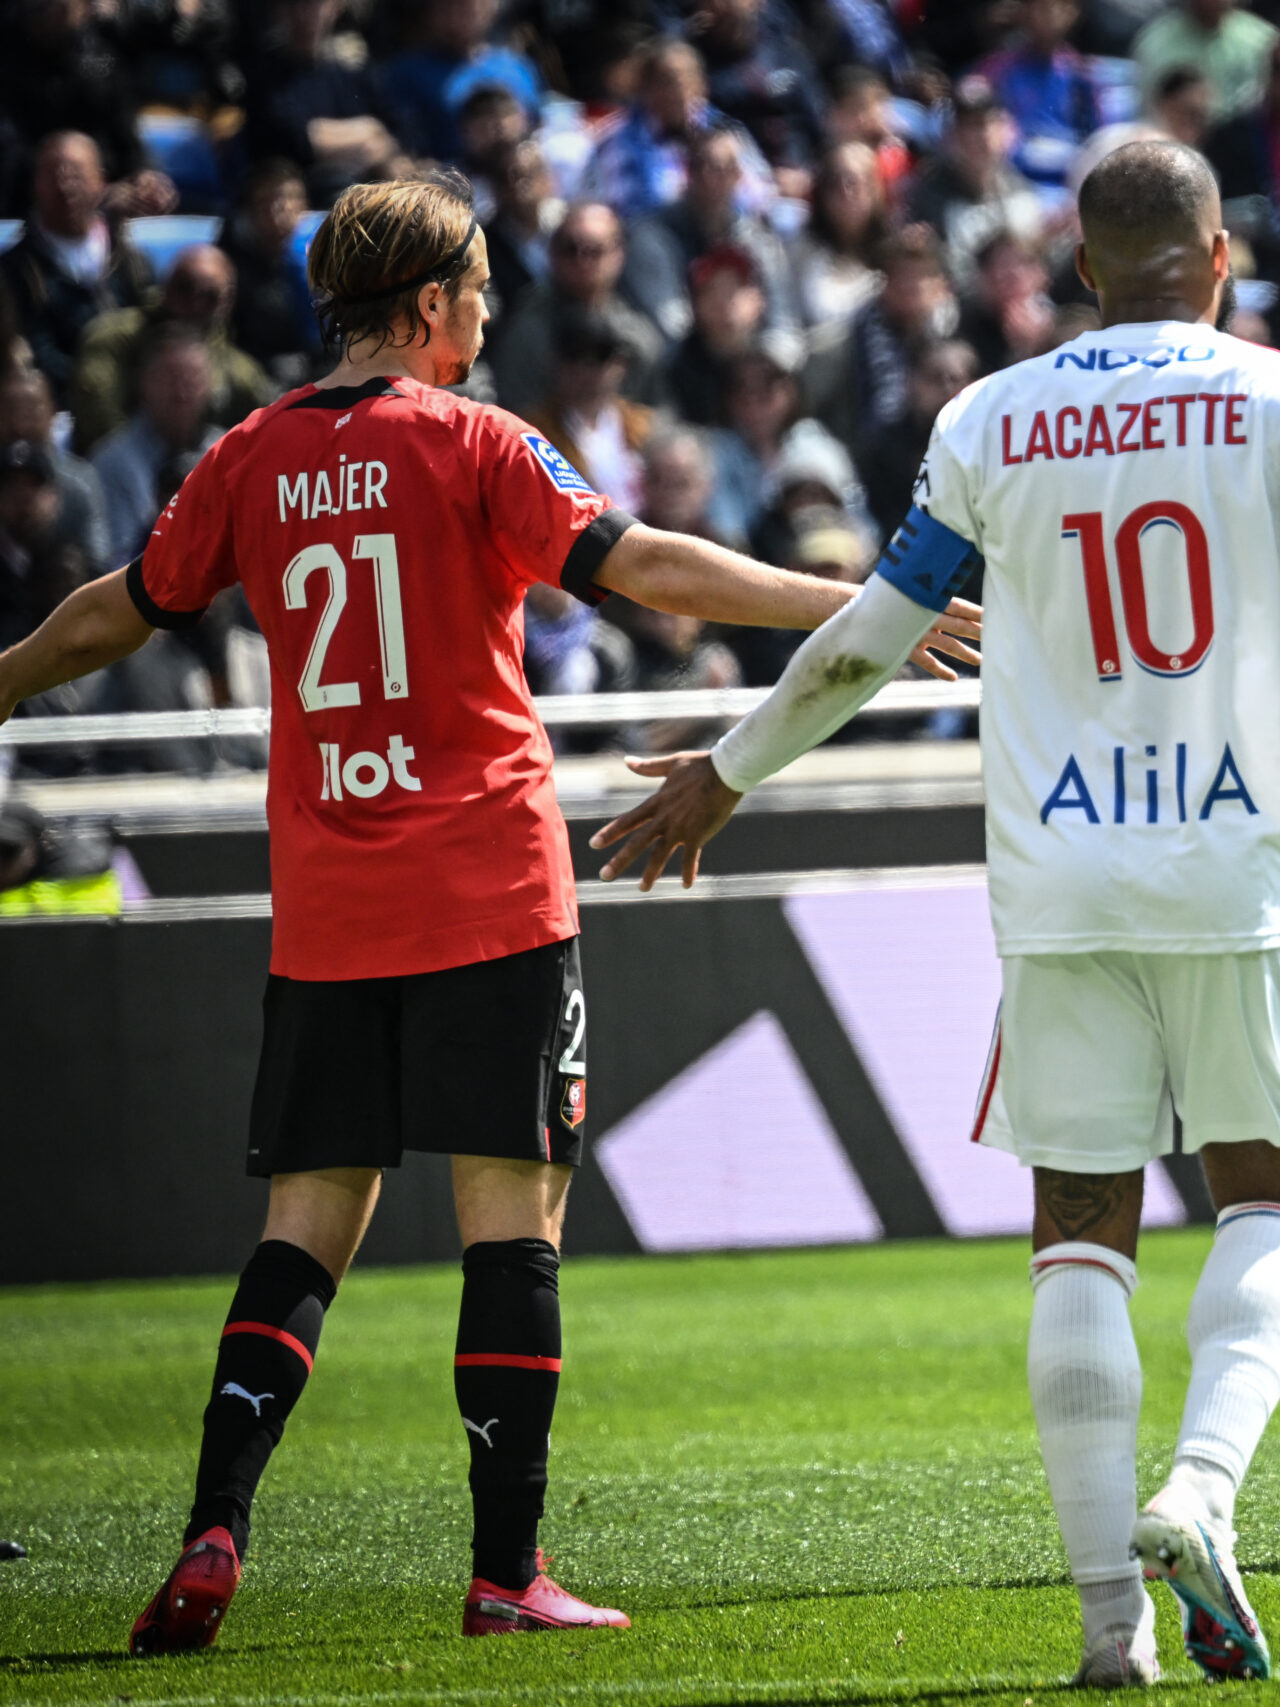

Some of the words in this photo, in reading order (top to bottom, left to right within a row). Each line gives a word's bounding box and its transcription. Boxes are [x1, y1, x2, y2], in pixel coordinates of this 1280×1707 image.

[1002, 393, 1248, 467] LACAZETTE
[282, 533, 409, 713] 21
[1060, 500, 1215, 683] 10
[558, 989, 586, 1076] 2
